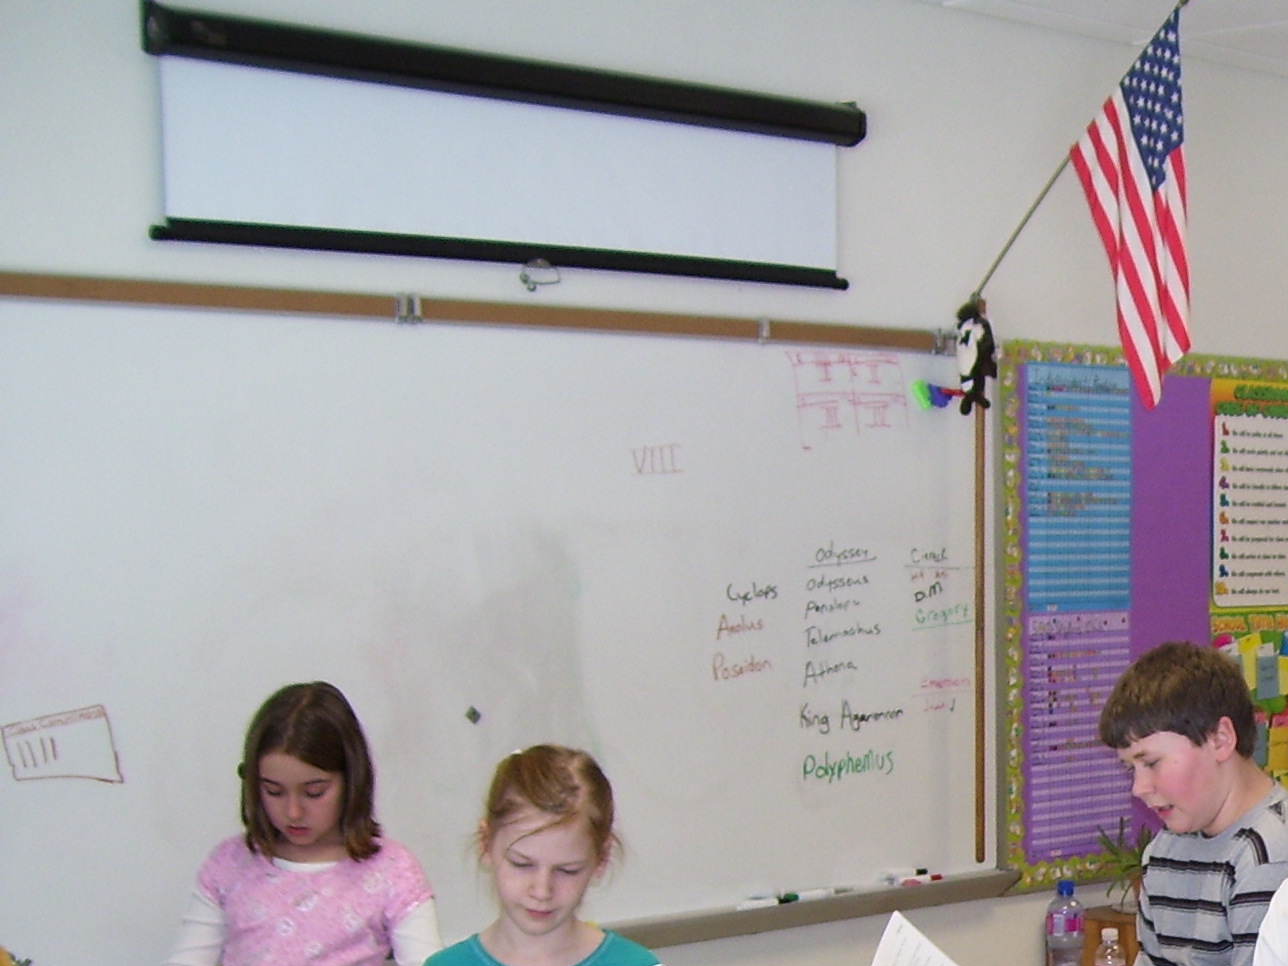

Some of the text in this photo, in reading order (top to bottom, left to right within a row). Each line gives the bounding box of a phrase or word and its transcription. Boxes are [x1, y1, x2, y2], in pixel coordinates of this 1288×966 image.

[815, 540, 869, 564] Odyssey
[726, 583, 778, 606] Cyclops
[799, 702, 831, 734] King
